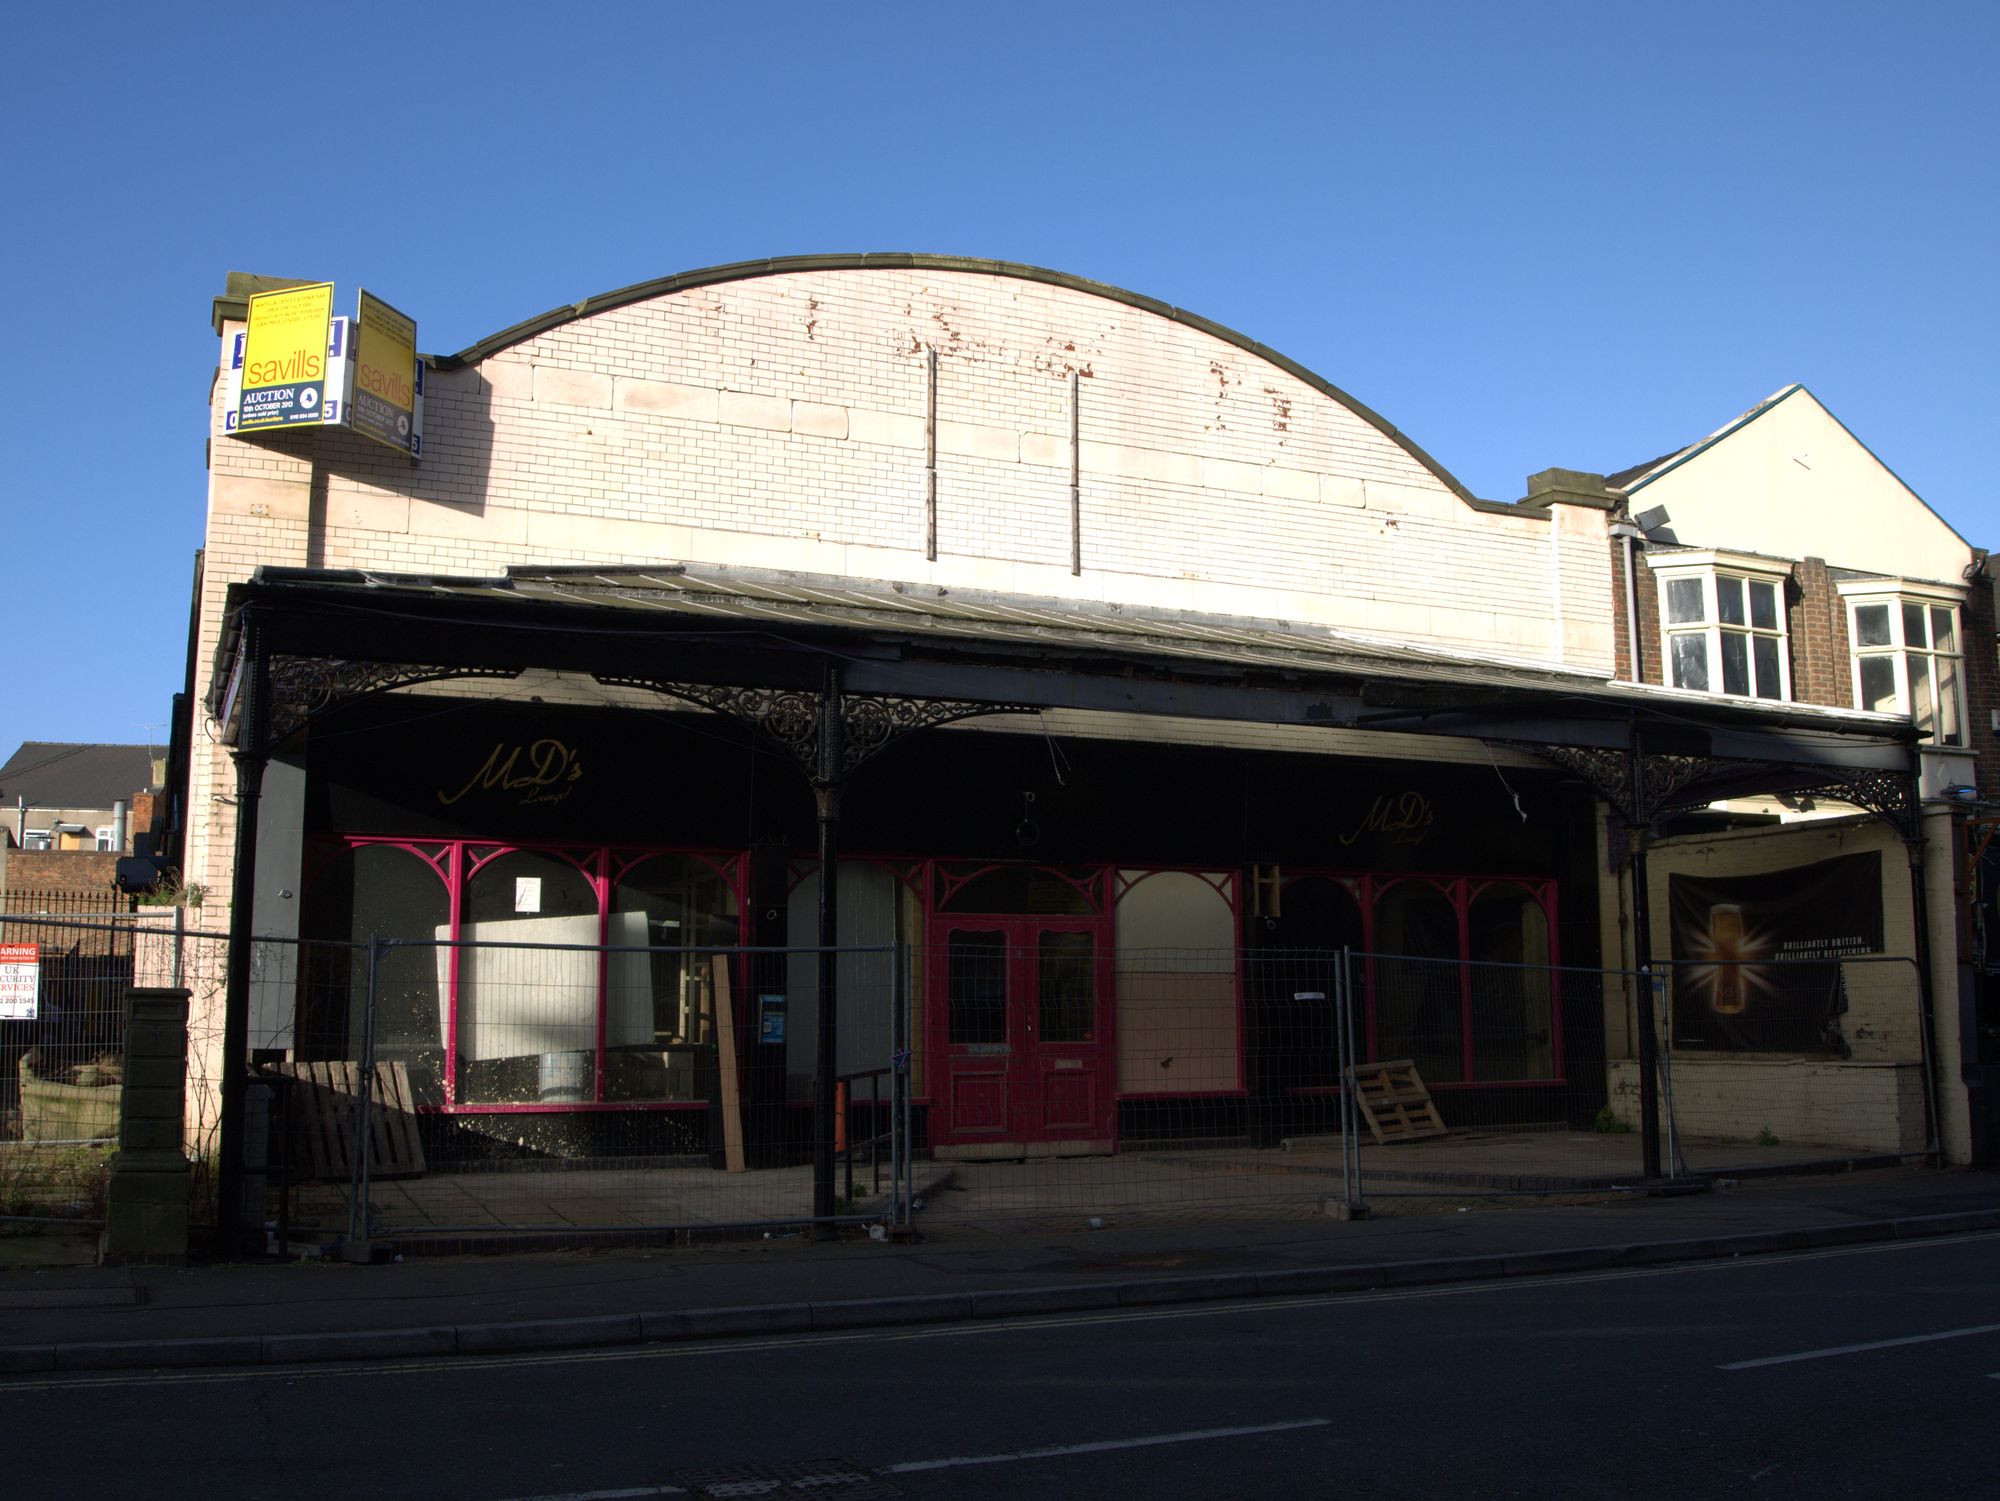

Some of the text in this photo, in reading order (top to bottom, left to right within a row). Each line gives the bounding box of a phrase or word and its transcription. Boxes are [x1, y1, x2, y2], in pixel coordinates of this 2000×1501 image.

[248, 349, 320, 385] savills
[360, 364, 410, 407] savills
[243, 388, 296, 405] AUCTION
[254, 402, 281, 412] OCTOBER
[356, 394, 395, 417] AUCTION
[437, 737, 584, 806] MD's
[1783, 939, 1829, 950] BRILLIANTLY
[1775, 950, 1821, 961] BRILLIANTLY
[5, 966, 19, 974] UK
[0, 983, 34, 991] RVICES
